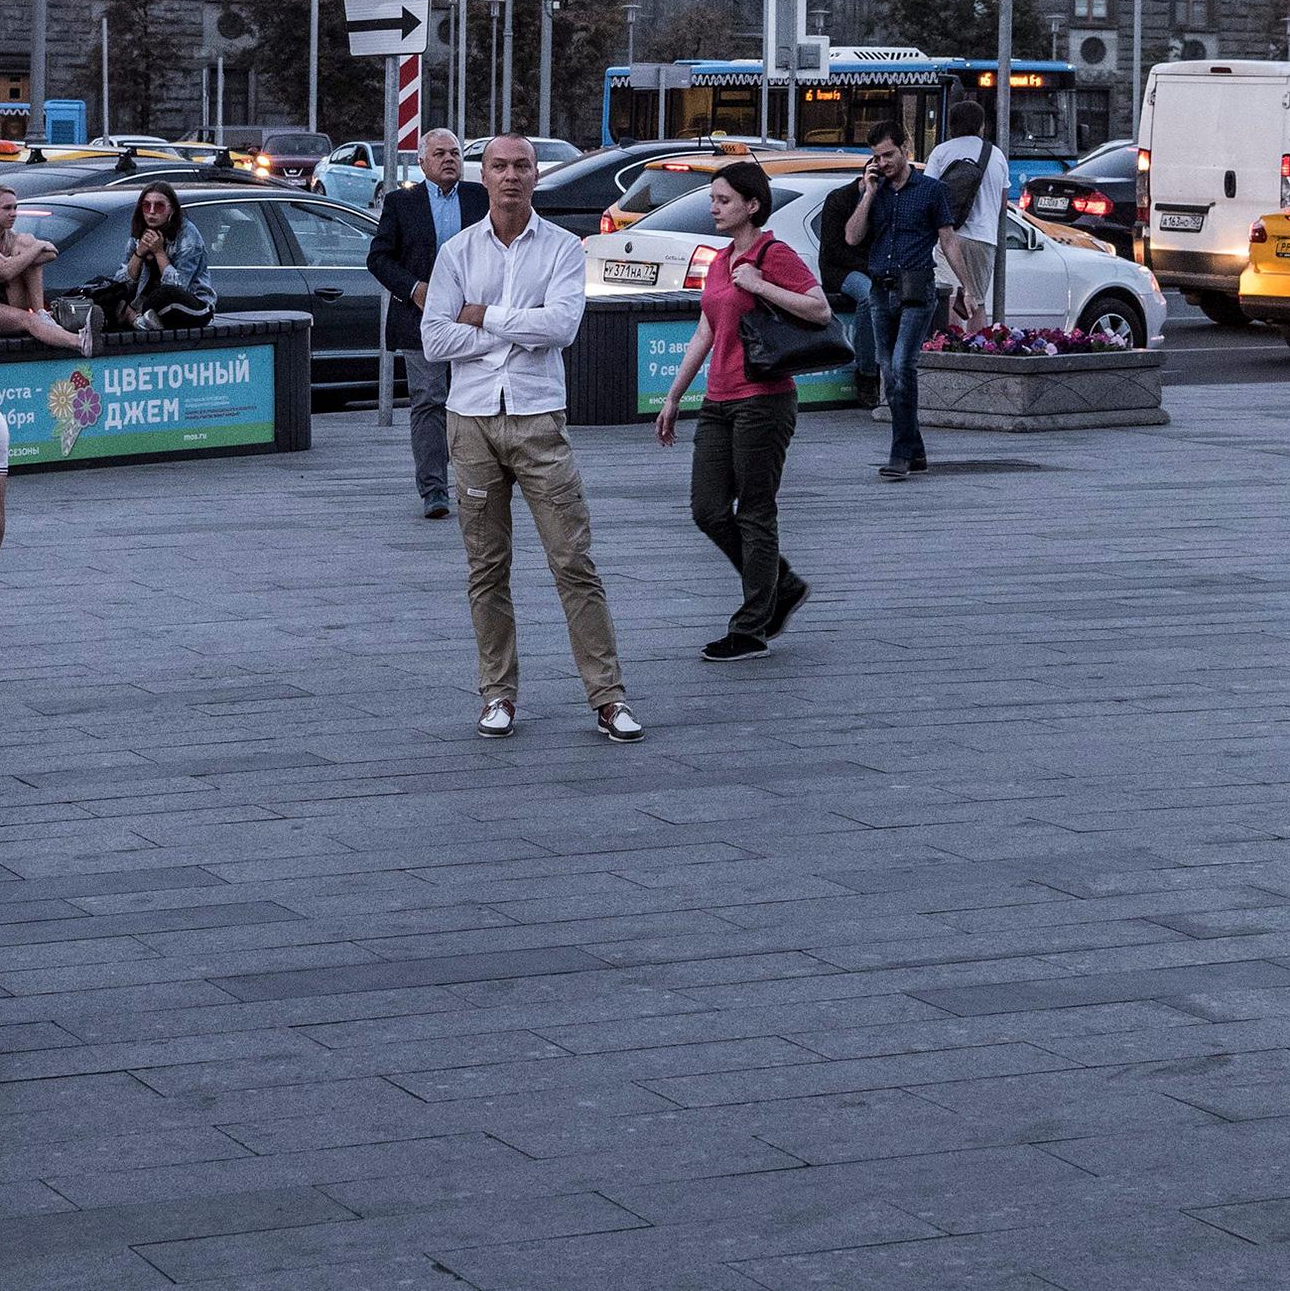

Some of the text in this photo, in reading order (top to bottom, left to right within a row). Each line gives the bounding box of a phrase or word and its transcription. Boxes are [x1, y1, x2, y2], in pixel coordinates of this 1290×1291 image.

[649, 339, 666, 355] 30
[104, 353, 250, 396] ЦВЕТОЧНЫЙ
[649, 362, 658, 377] 9
[104, 398, 180, 431] ДЖЕМ
